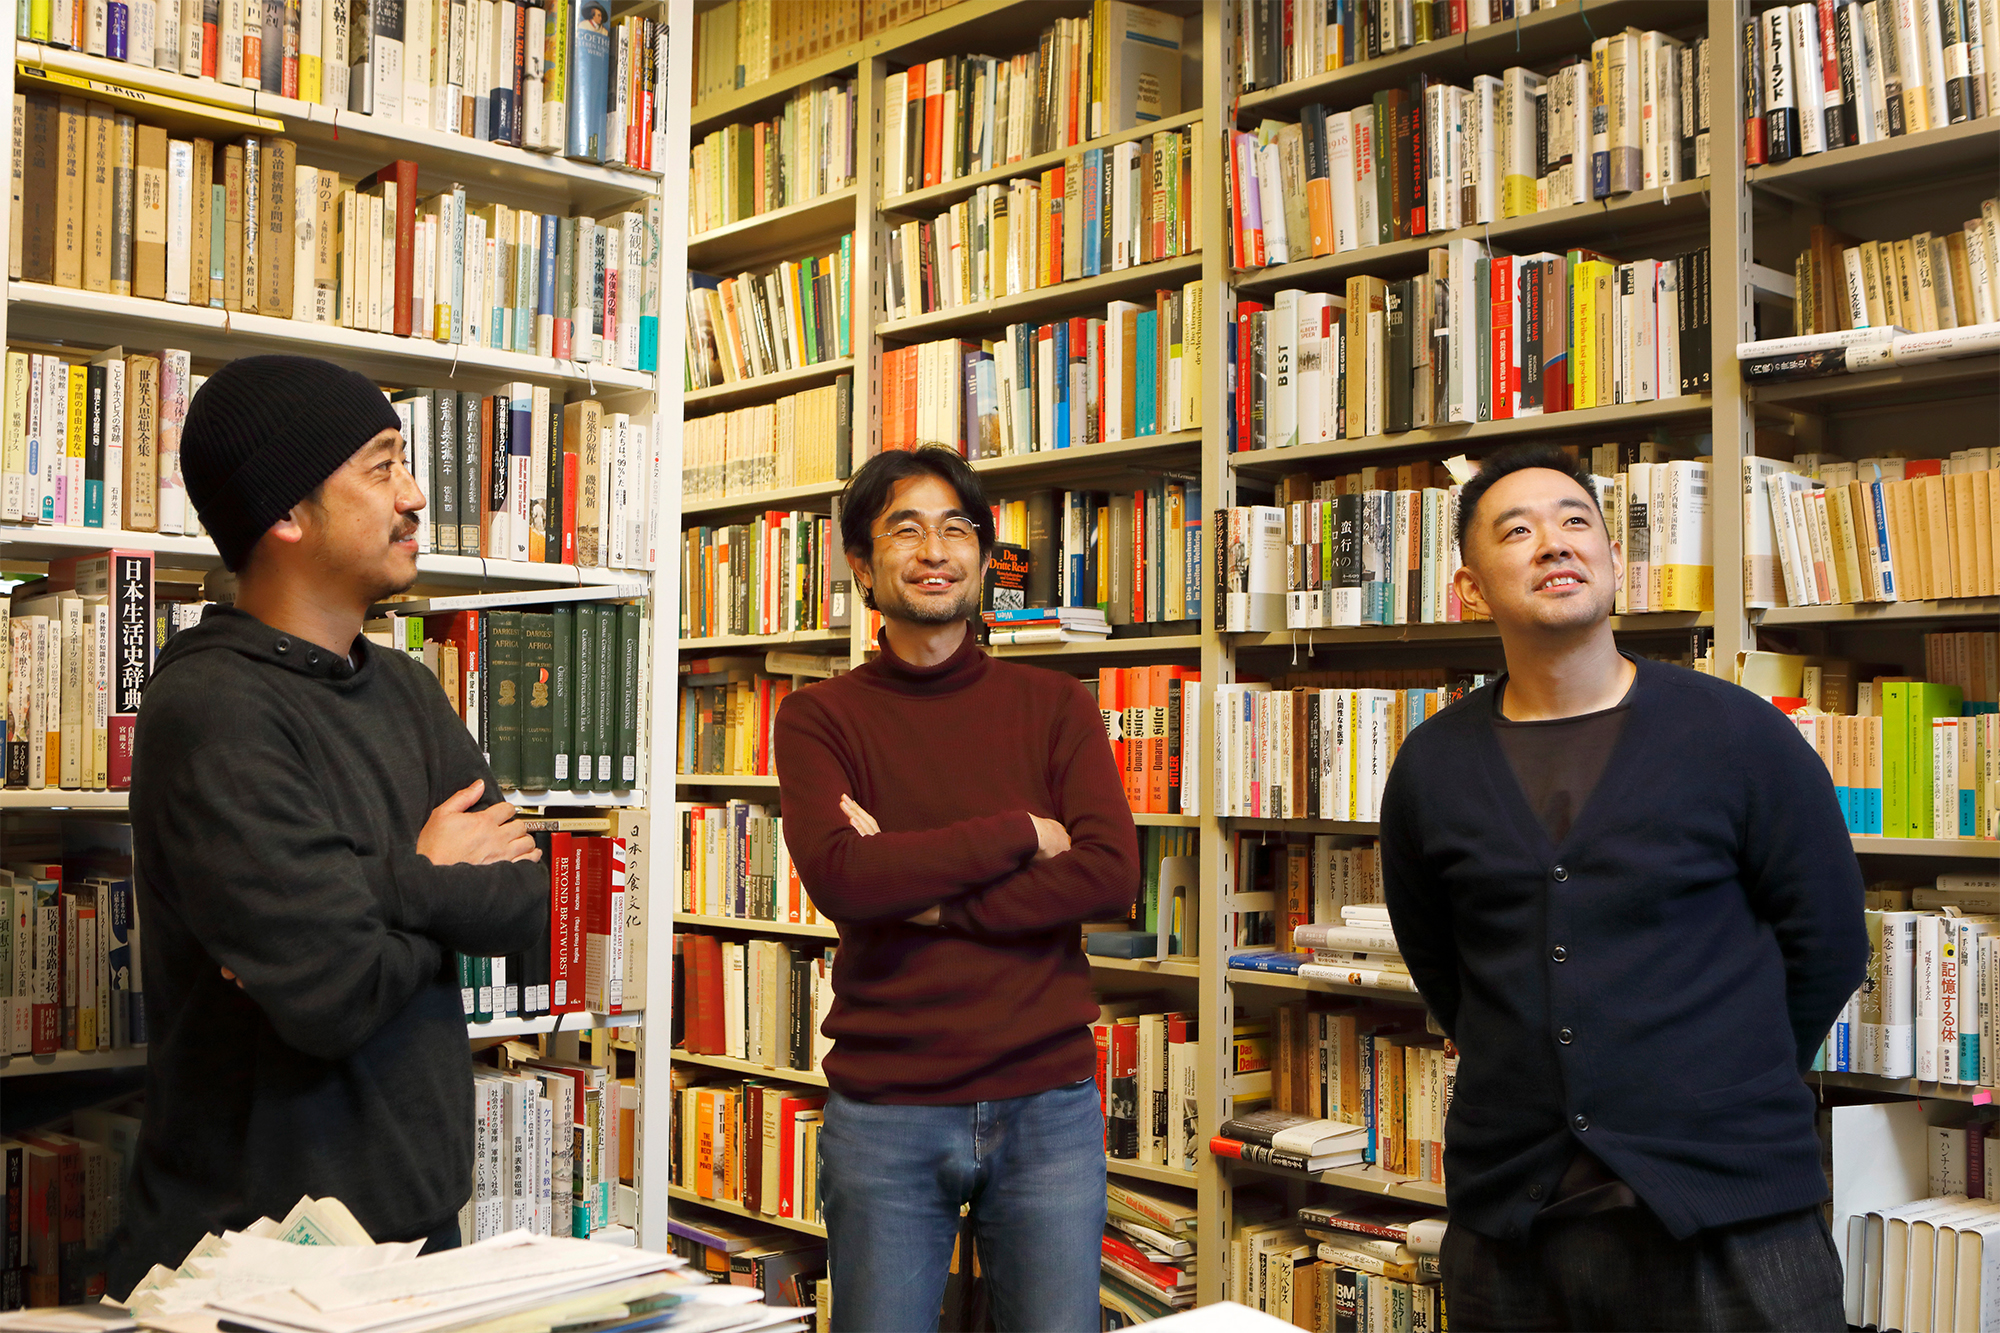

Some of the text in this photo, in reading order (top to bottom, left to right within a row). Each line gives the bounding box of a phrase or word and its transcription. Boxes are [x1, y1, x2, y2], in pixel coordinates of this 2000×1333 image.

[514, 6, 525, 67] MORAL TALES
[1770, 14, 1784, 102] ヒトラーランド
[13, 105, 23, 179] 現代福祉国家論
[66, 107, 77, 178] 生命再生産の理論
[1328, 135, 1348, 150] 1918
[1411, 107, 1422, 200] THE WAFFEN-SS
[270, 148, 285, 234] 政治經濟學の問題
[1086, 166, 1096, 221] GESCHICHTE
[1153, 149, 1163, 191] 1918
[321, 177, 332, 213] 母の手
[1103, 163, 1113, 239] NATUR MACHT
[629, 218, 642, 266] 客観性
[247, 256, 255, 296] 大熊信行
[594, 234, 605, 299] 新潟水俣病
[1531, 267, 1539, 281] THE
[1626, 267, 1635, 295] PIPER
[1690, 255, 1698, 289] Verbrechens
[316, 283, 327, 322] 革新的歌集
[1195, 286, 1204, 366] der Mechanisierung
[1277, 344, 1289, 387] BEST
[1578, 303, 1588, 405] Die Reihen geschlossen
[1702, 372, 1710, 381] 3
[1749, 357, 1808, 380] 〈内戦〉の世界史
[14, 358, 24, 409] 漂泊のアーレント
[111, 365, 122, 443] こどもホスピスの奇跡
[1682, 379, 1689, 388] 2
[1692, 378, 1699, 386] 1
[12, 411, 21, 452] 戦場のヨナス
[73, 383, 84, 458] 学問の自由が危ない
[138, 369, 151, 457] 世界大思想全集
[586, 411, 597, 465] 建築の解体
[110, 487, 119, 517] 石井光太
[585, 474, 596, 508] 磯崎新
[1656, 491, 1665, 534] 時間と権力
[1670, 470, 1680, 545] スペイン内戦と国際旅団
[989, 557, 1012, 571] Dritte
[1003, 549, 1018, 562] Das
[1185, 530, 1193, 585] Eisenbahnen
[1340, 519, 1352, 568] 蛮行の
[18, 630, 29, 679] 荷を引く獣たち
[121, 560, 145, 711] 日本生活史辞典
[494, 639, 520, 649] AFRICA
[1133, 708, 1145, 739] Hitler
[1152, 707, 1165, 738] Hitler
[1170, 697, 1179, 788] HITLER EINE BILANZ
[1336, 694, 1344, 746] 人間性なき医学
[1133, 740, 1143, 772] Domarus
[1153, 738, 1163, 771] Domarus
[625, 824, 643, 929] 日本の食文化
[67, 900, 75, 957] ゴドーを待ちながら
[559, 857, 569, 978] BEYOND BRATWURST
[18, 931, 28, 998] むずかしい天皇制
[46, 907, 59, 1004] 医者、用水路を拓く
[1883, 923, 1895, 977] 概念と生
[1960, 937, 1969, 967] 手の倫理
[45, 1008, 55, 1040] 中村哲
[1941, 962, 1957, 1043] 記憶する体
[1239, 1044, 1253, 1056] Das
[1430, 1058, 1438, 1112] 普通の人びと
[542, 1108, 551, 1200] ケアとアートの教室
[700, 1139, 712, 1148] THIRD
[700, 1147, 712, 1155] REICH
[703, 1132, 711, 1140] THE
[699, 1162, 712, 1171] POWER
[1397, 1289, 1405, 1327] ヒトラー
